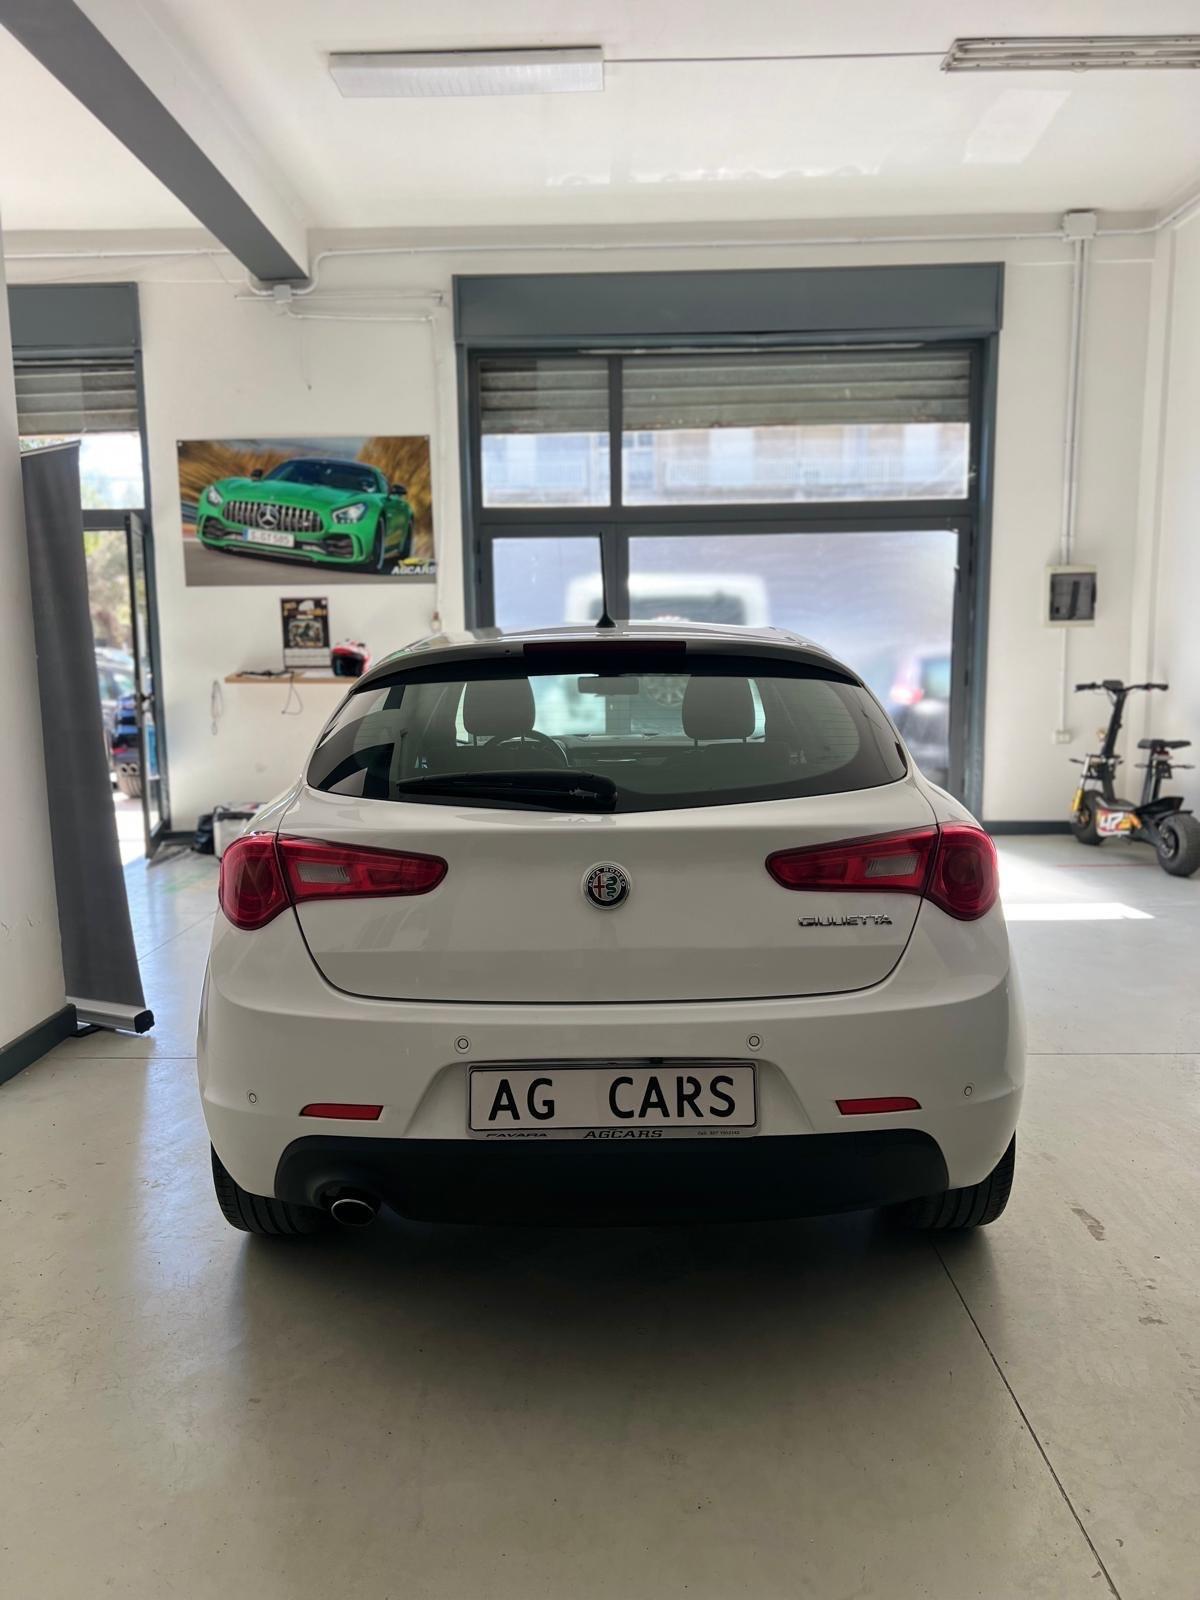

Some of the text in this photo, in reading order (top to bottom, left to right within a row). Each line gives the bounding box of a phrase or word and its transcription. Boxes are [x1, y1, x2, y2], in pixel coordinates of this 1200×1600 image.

[798, 914, 893, 927] GIULIETTA
[488, 1075, 736, 1121] AG CARS
[583, 1129, 664, 1139] AGCARS
